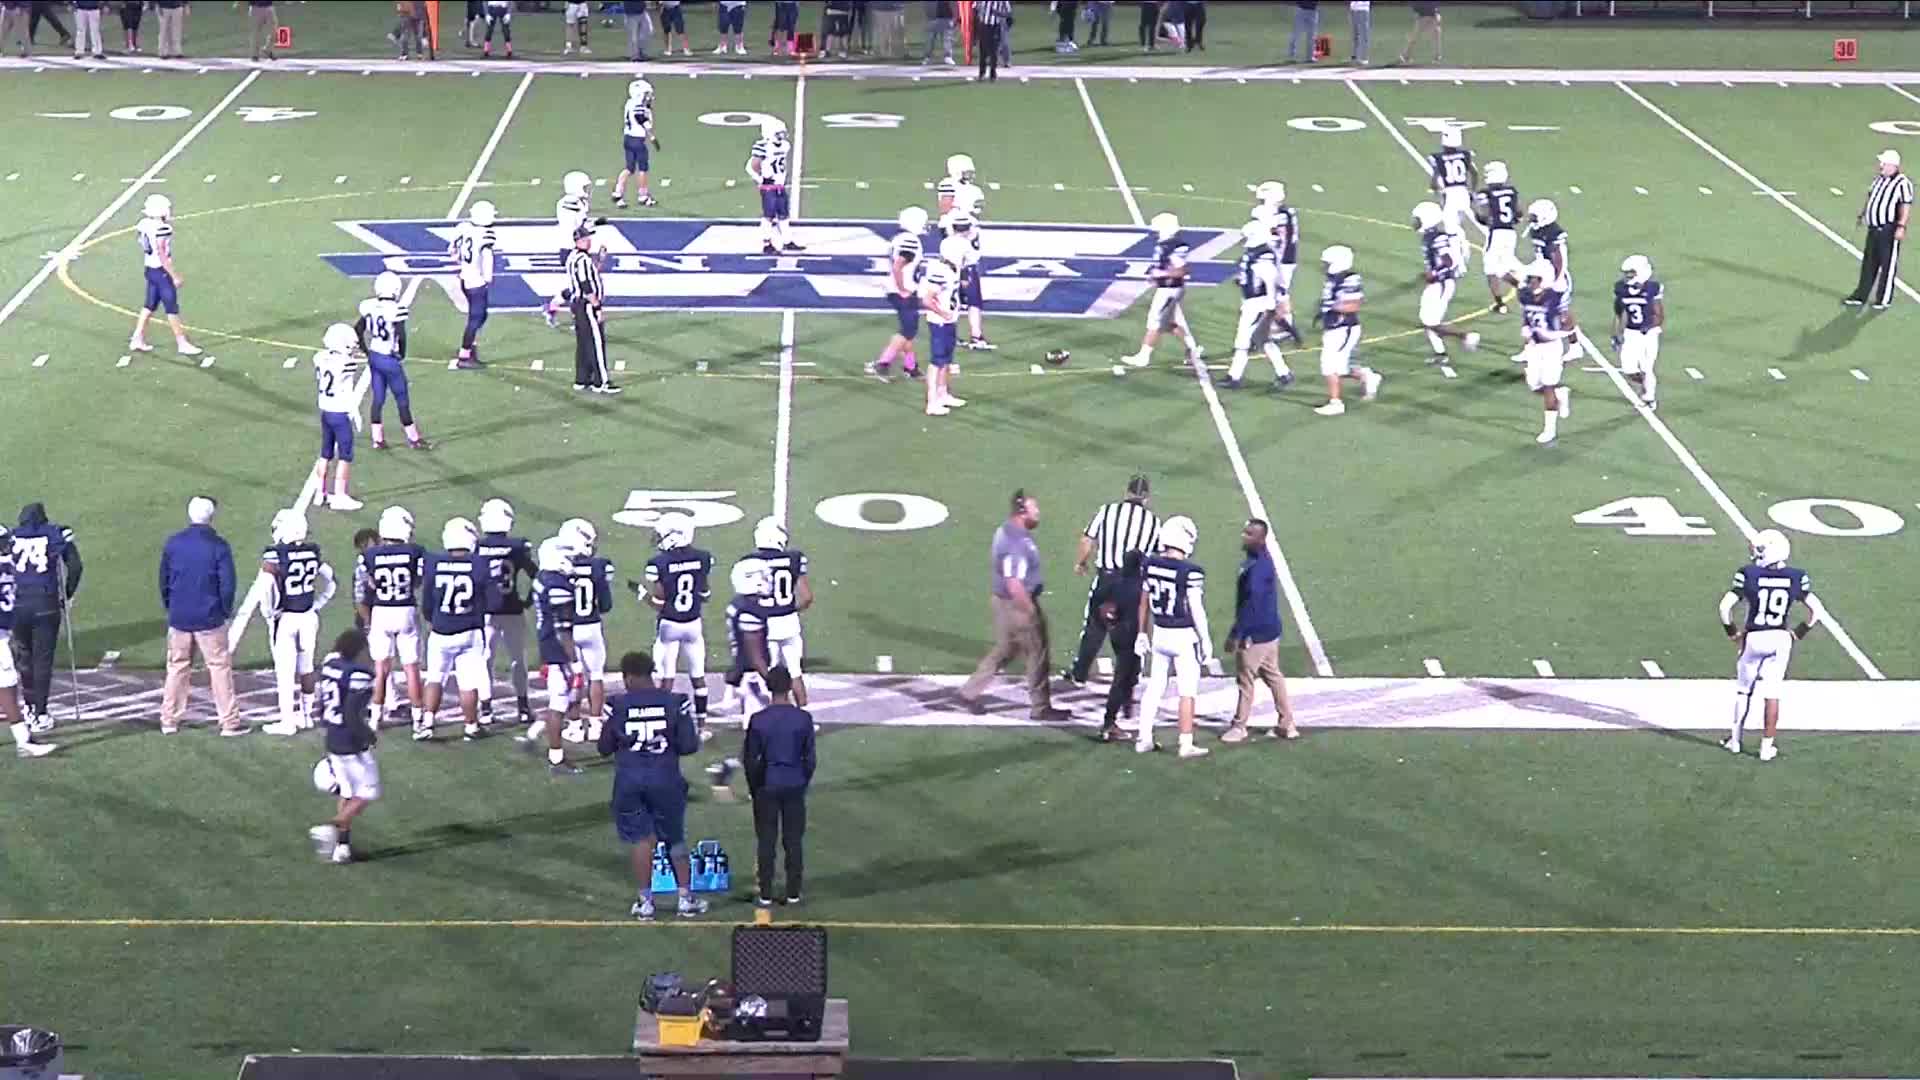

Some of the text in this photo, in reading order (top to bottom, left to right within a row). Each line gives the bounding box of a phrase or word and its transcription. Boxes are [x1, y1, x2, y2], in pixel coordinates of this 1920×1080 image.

[1836, 41, 1855, 56] 30
[1444, 159, 1466, 183] 10
[1499, 196, 1513, 223] 5
[1628, 304, 1643, 324] 3
[12, 536, 48, 573] 74
[285, 561, 318, 596] 22
[374, 567, 411, 601] 38
[435, 575, 473, 615] 72
[674, 573, 694, 612] 8
[1142, 577, 1177, 616] 27
[1754, 588, 1789, 627] 19
[625, 720, 668, 754] 75
